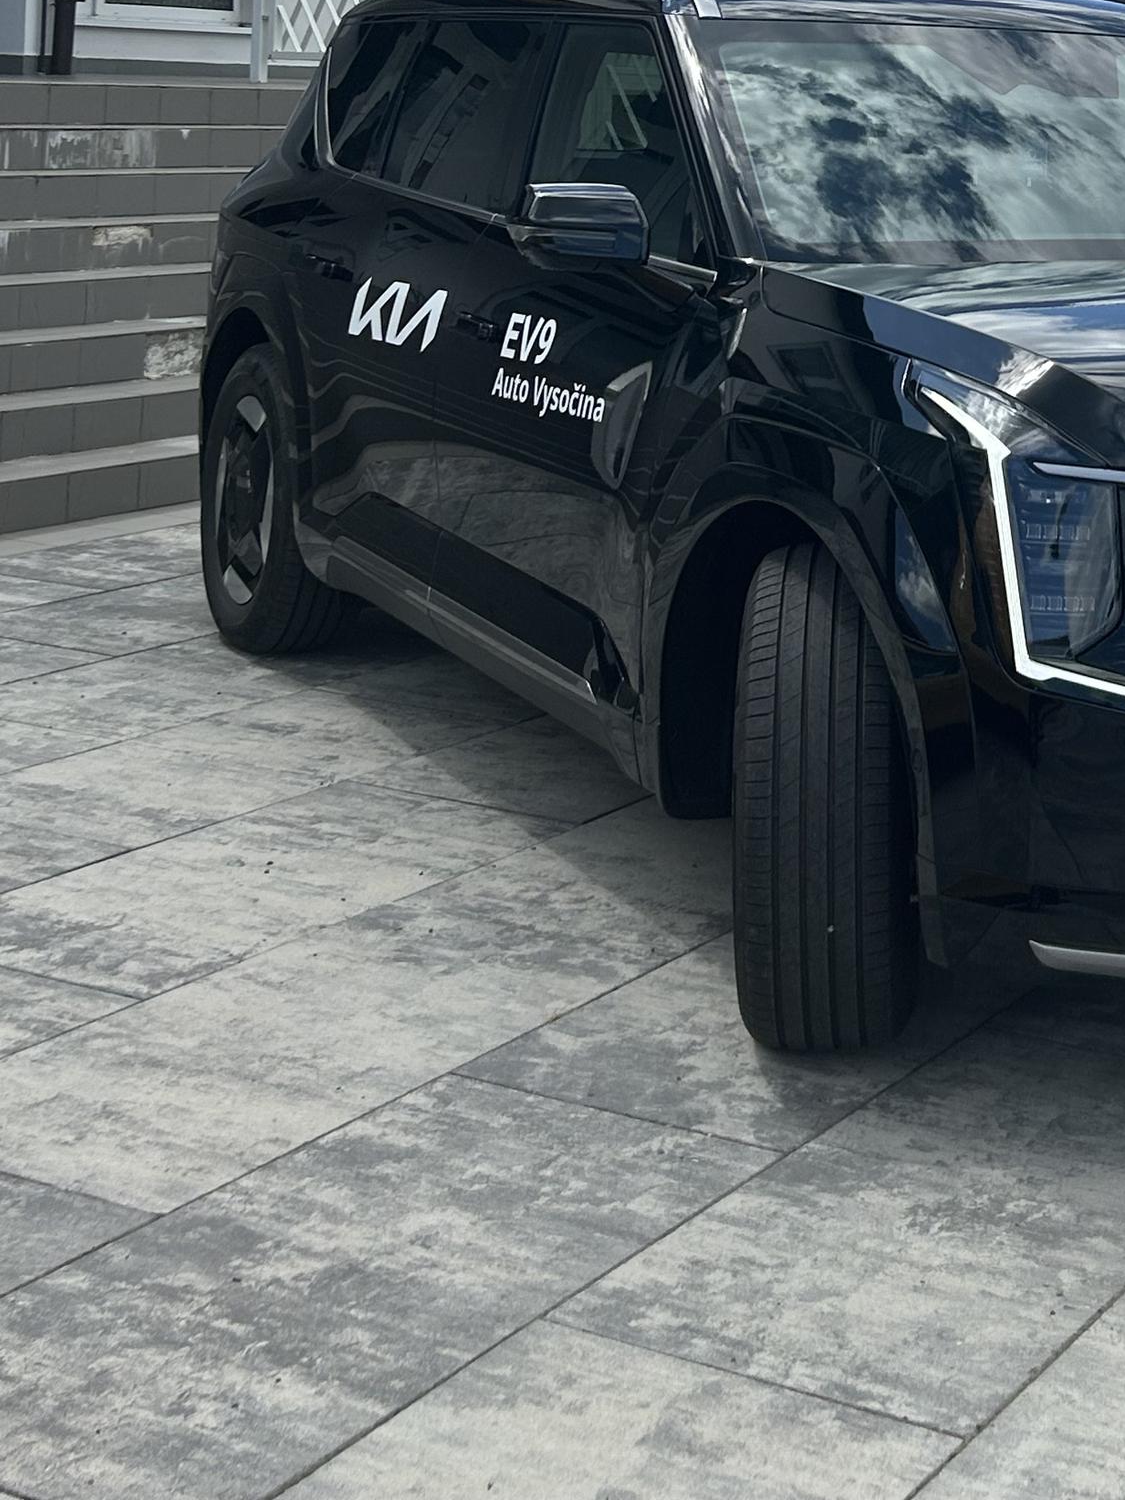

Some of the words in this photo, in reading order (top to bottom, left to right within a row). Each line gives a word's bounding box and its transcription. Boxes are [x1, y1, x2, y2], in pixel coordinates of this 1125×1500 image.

[348, 276, 449, 353] KIA
[500, 312, 558, 365] EV9
[491, 367, 530, 404] Auto
[533, 375, 606, 423] Vysočina
